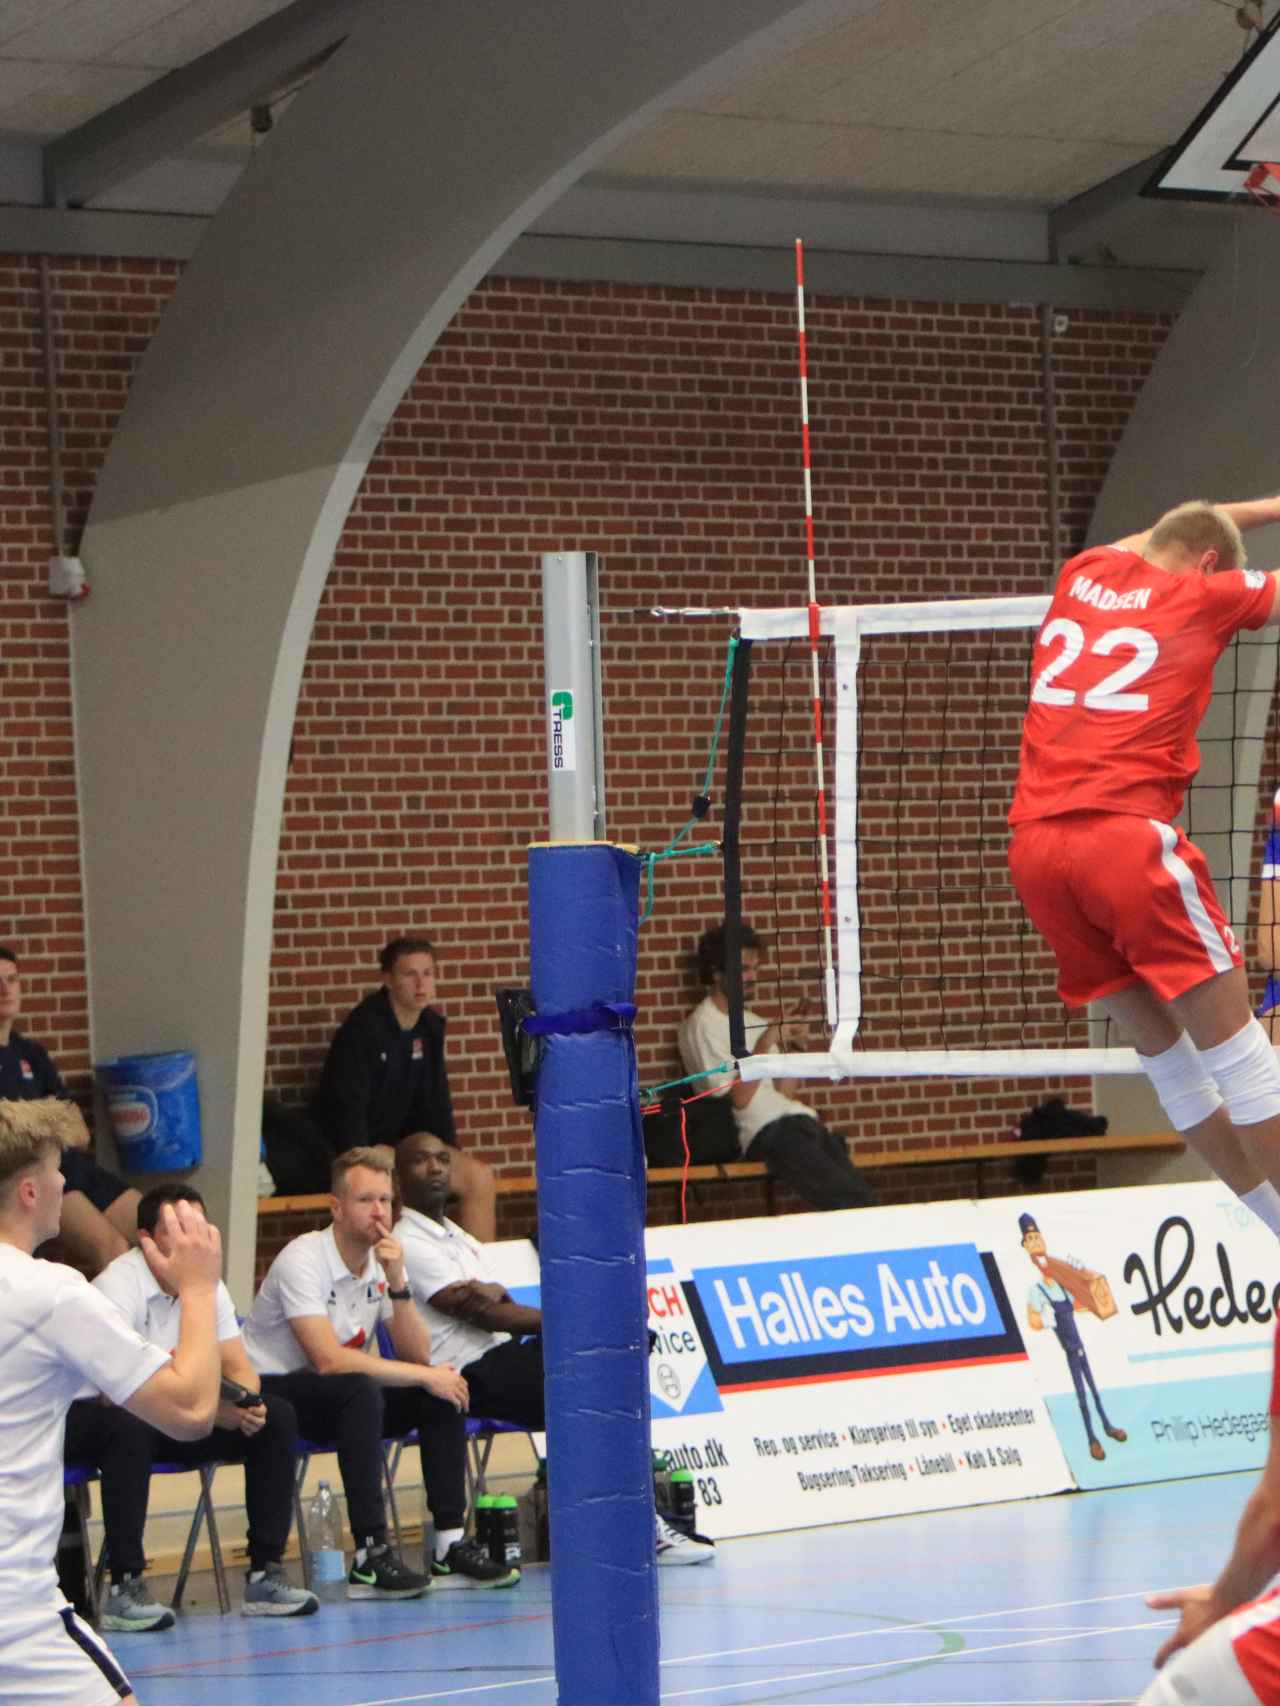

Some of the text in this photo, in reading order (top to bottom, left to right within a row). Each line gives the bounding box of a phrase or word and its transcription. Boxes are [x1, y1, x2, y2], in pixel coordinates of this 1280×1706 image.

[1069, 575, 1152, 611] MADSEN
[1032, 618, 1159, 711] 22
[553, 708, 565, 769] TRESS
[647, 1284, 684, 1319] CH
[712, 1260, 987, 1350] Halles Auto
[753, 1436, 781, 1457] Rep.
[782, 1437, 799, 1455] og
[798, 1429, 839, 1452] service
[905, 1418, 920, 1438] til
[921, 1419, 940, 1439] syn
[947, 1413, 974, 1434] Eget
[974, 1407, 1036, 1430] skadecenter
[697, 1475, 723, 1507] 83
[797, 1465, 855, 1492] Bugsering
[852, 1460, 908, 1483] Taksering
[989, 1449, 997, 1466] &
[998, 1446, 1023, 1467] Salg
